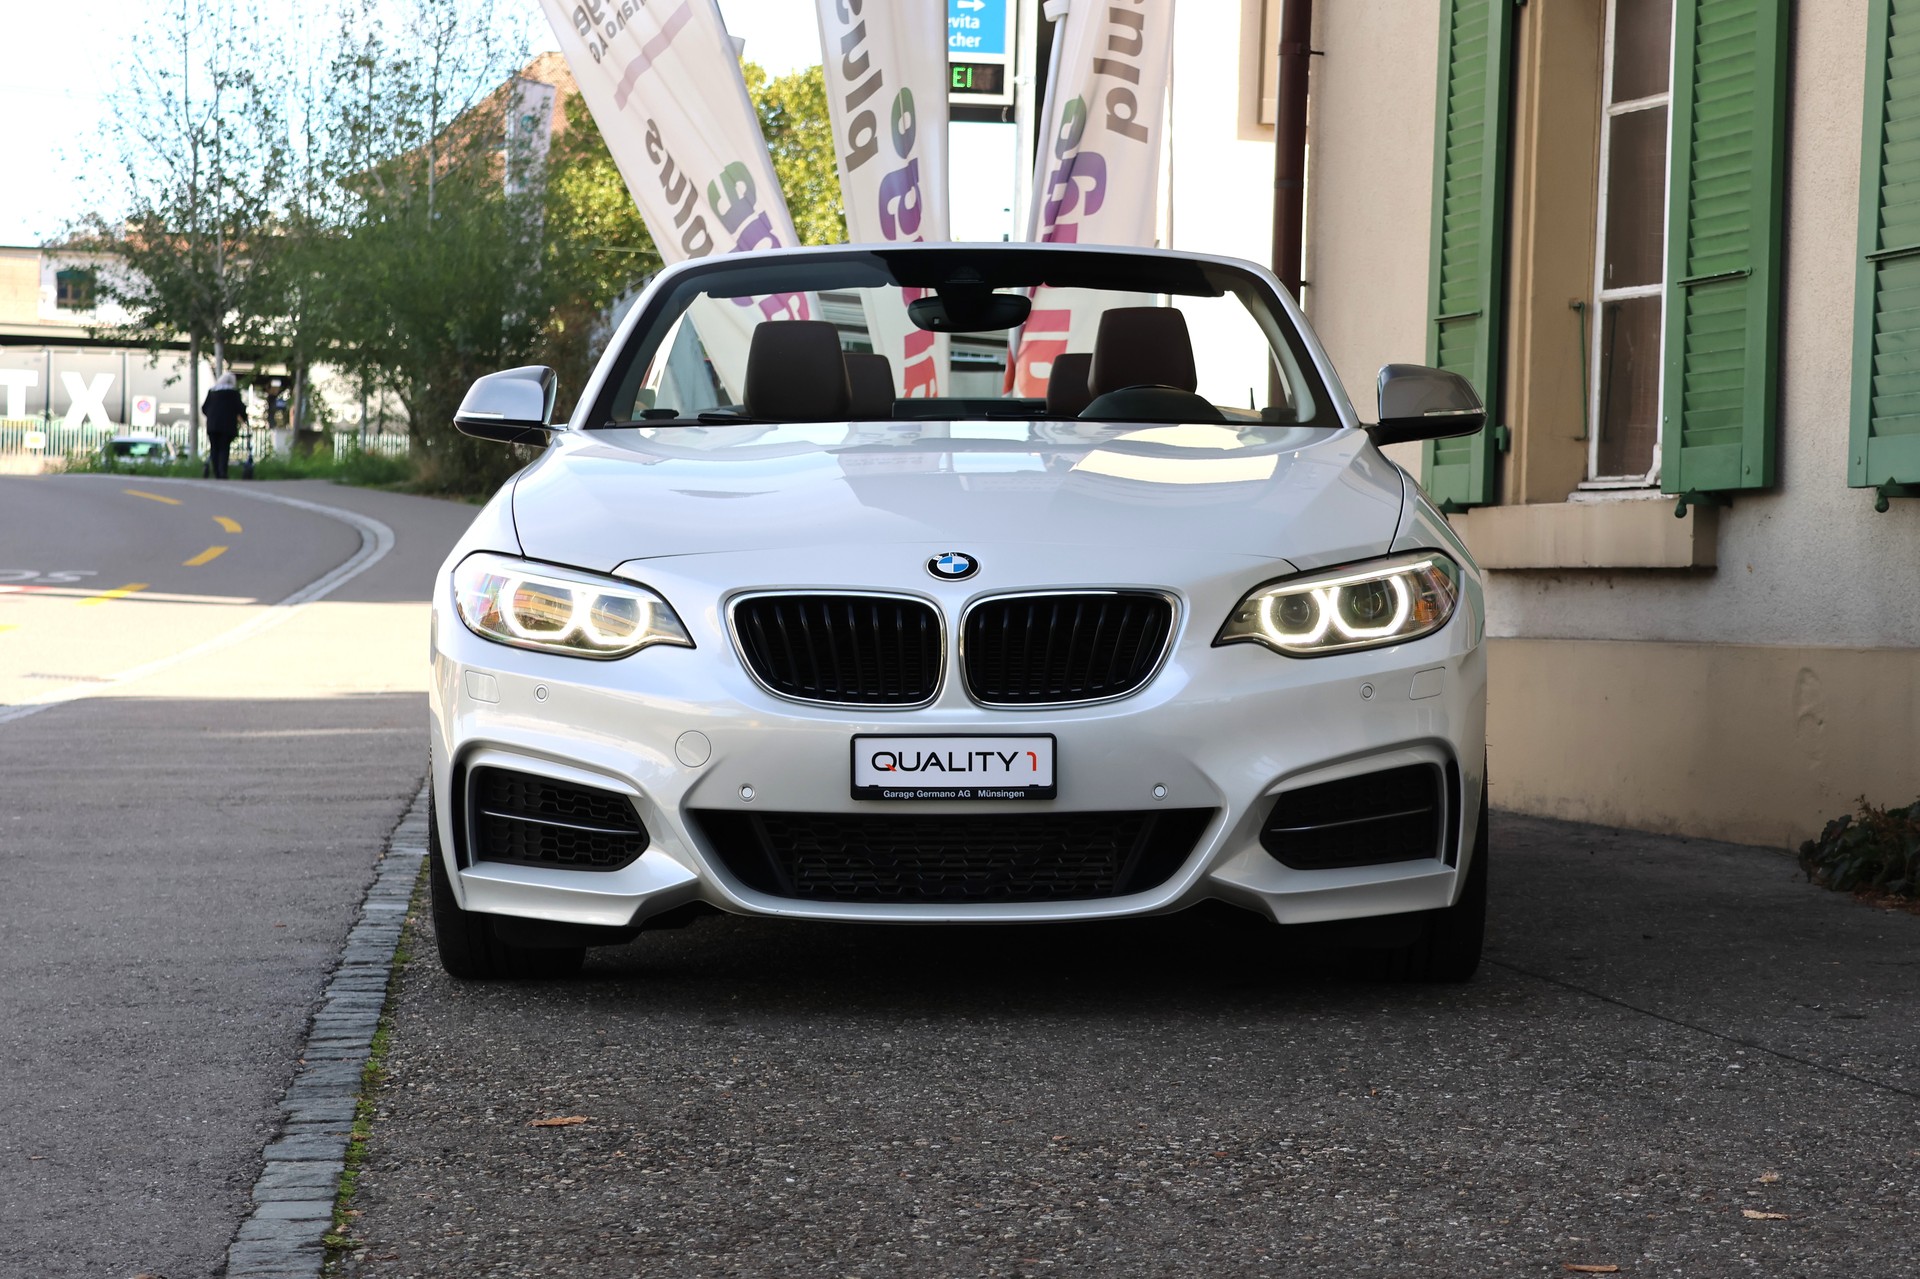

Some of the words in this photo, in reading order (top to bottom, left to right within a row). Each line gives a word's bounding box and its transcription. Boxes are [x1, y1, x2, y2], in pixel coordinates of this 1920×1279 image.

[1093, 0, 1149, 143] plu
[871, 751, 1019, 772] QUALITY
[883, 790, 915, 799] Garage
[916, 790, 956, 798] Germano
[957, 790, 971, 798] AG
[977, 789, 1025, 799] Münsingen
